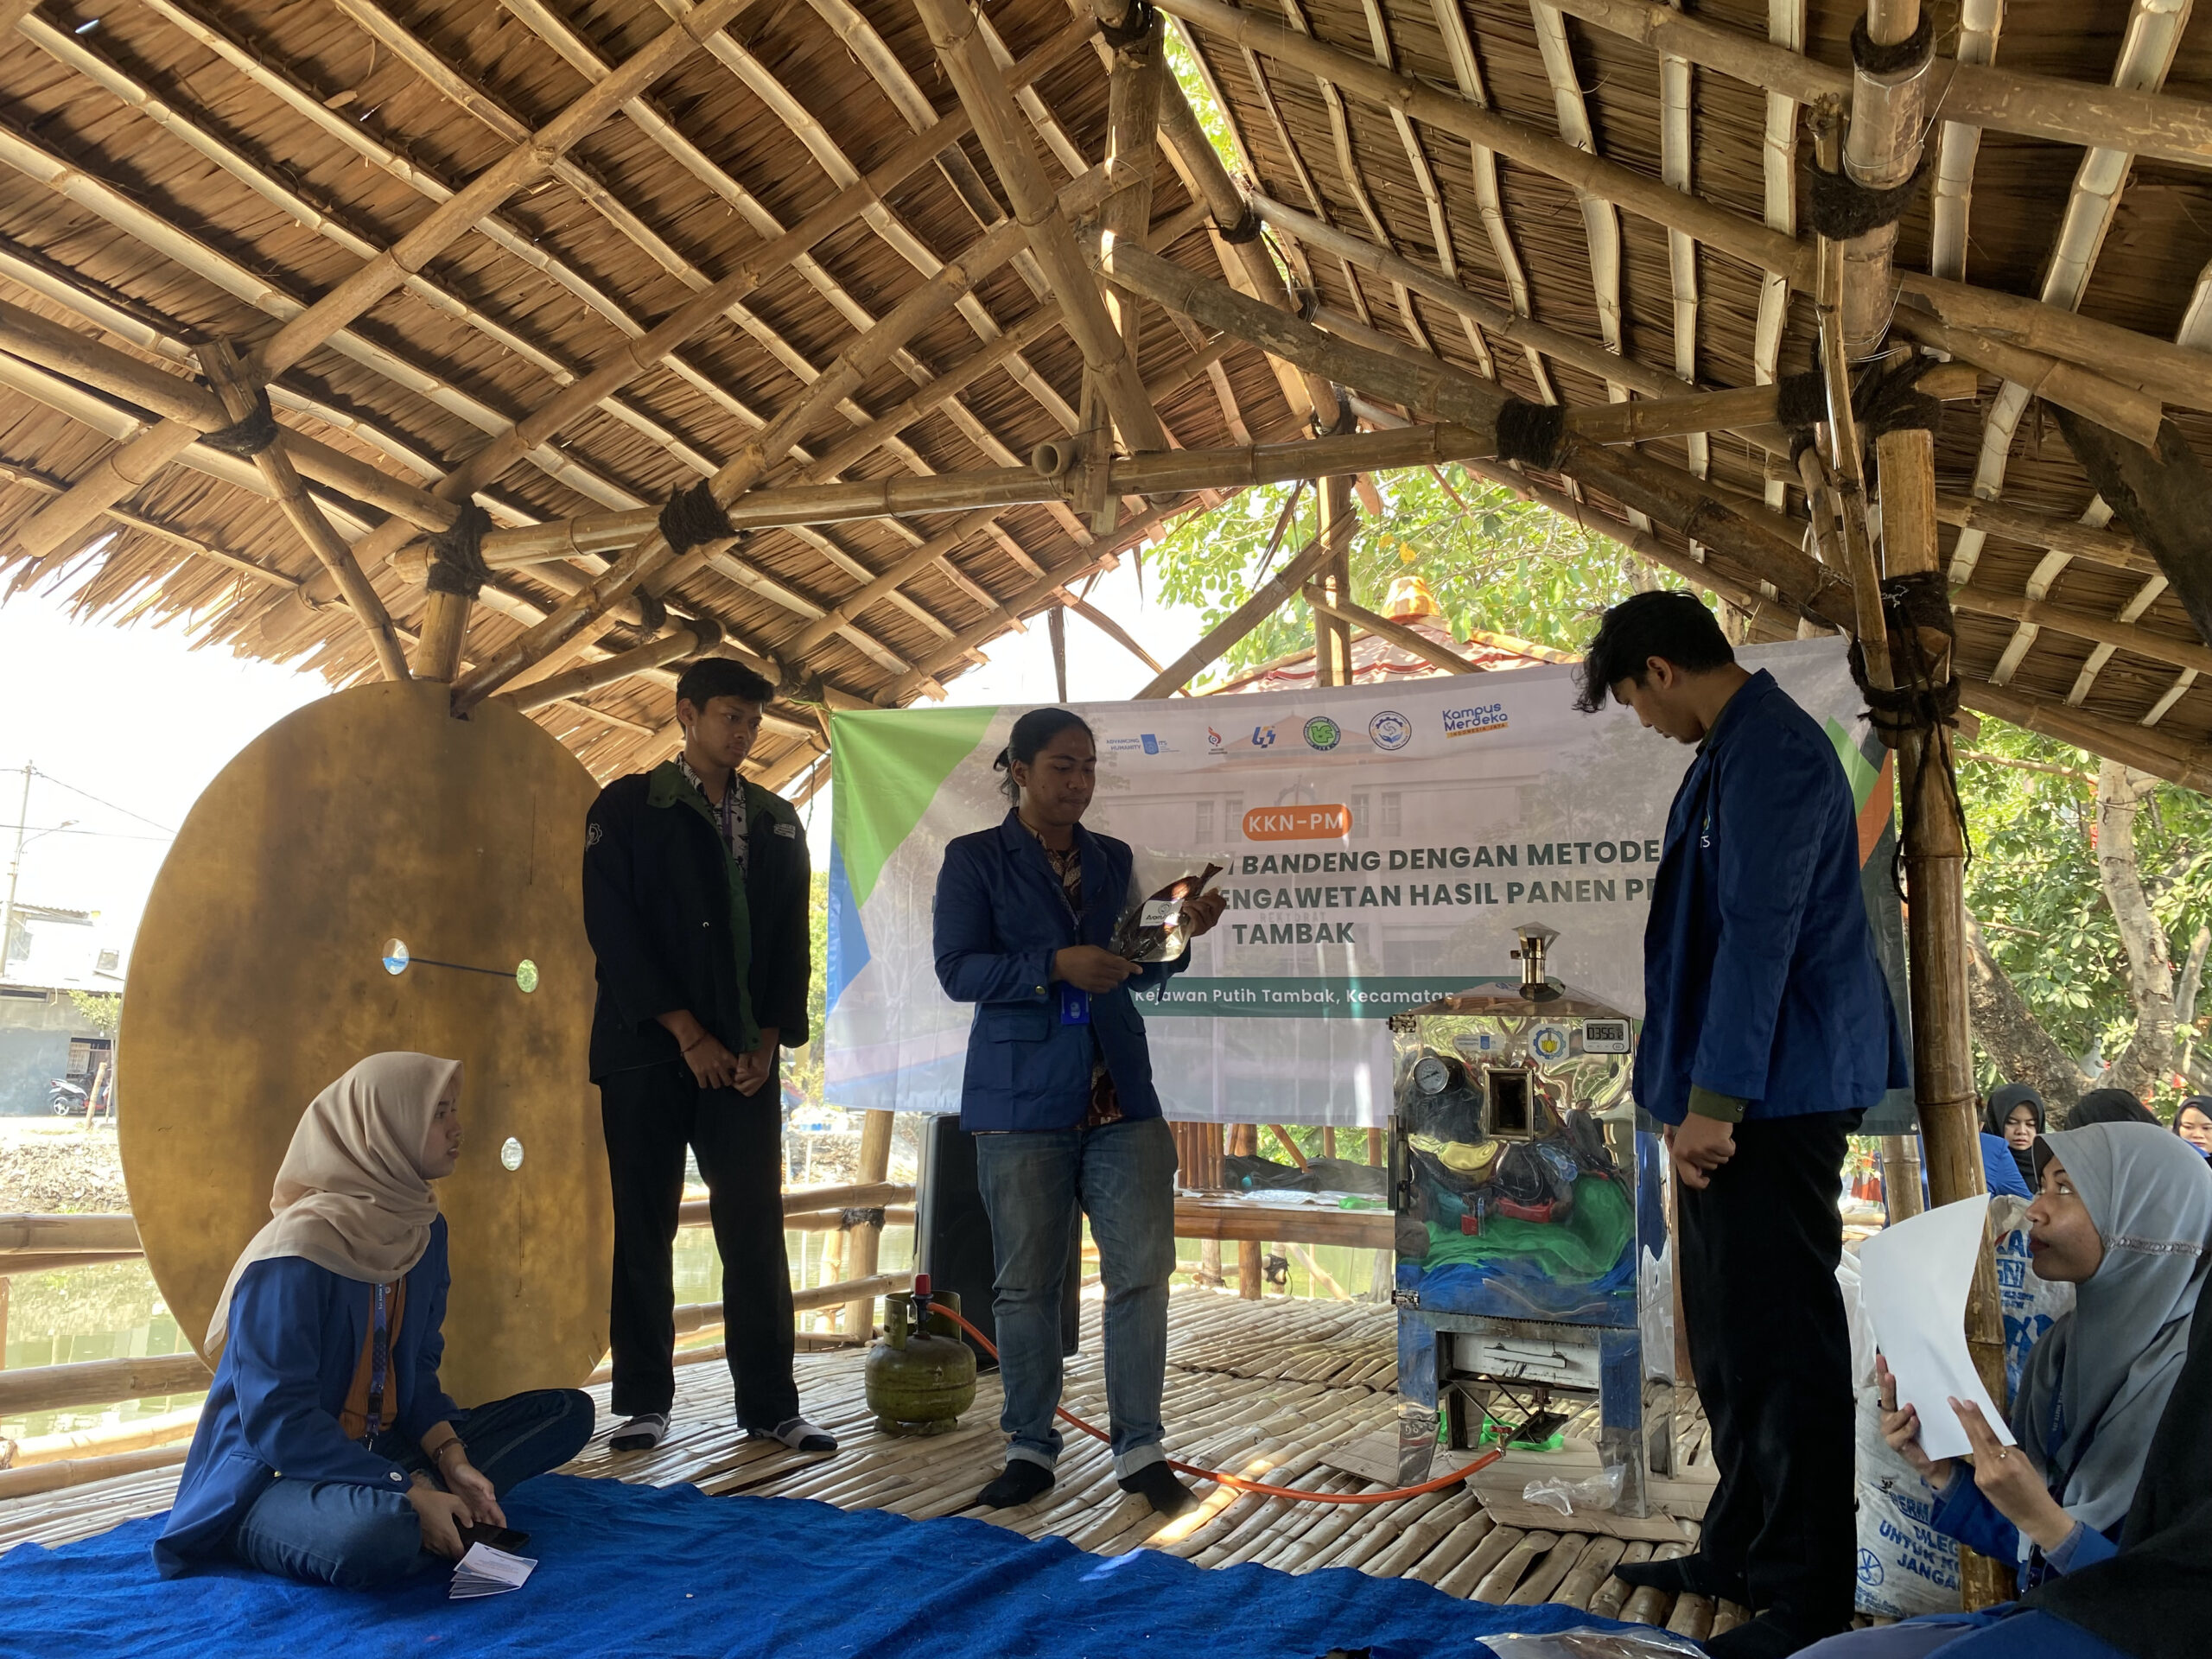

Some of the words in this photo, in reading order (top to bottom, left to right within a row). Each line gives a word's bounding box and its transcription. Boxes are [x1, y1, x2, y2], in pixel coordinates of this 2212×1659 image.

[1442, 702, 1502, 721] Kampus
[1444, 713, 1509, 732] Merdeka
[1248, 811, 1344, 833] KKN-PM
[1242, 850, 1381, 875] BANDENG
[1389, 844, 1517, 871] DENGAN
[1527, 840, 1661, 866] METODE
[1219, 884, 1402, 911] ENGAWETAN
[1410, 882, 1499, 906] HASIL
[1507, 880, 1616, 904] PANEN
[1232, 922, 1356, 944] TAMBAK
[1135, 988, 1207, 1006] Kejawan
[1213, 989, 1256, 1002] Putih
[1262, 989, 1341, 1004] Tambak,
